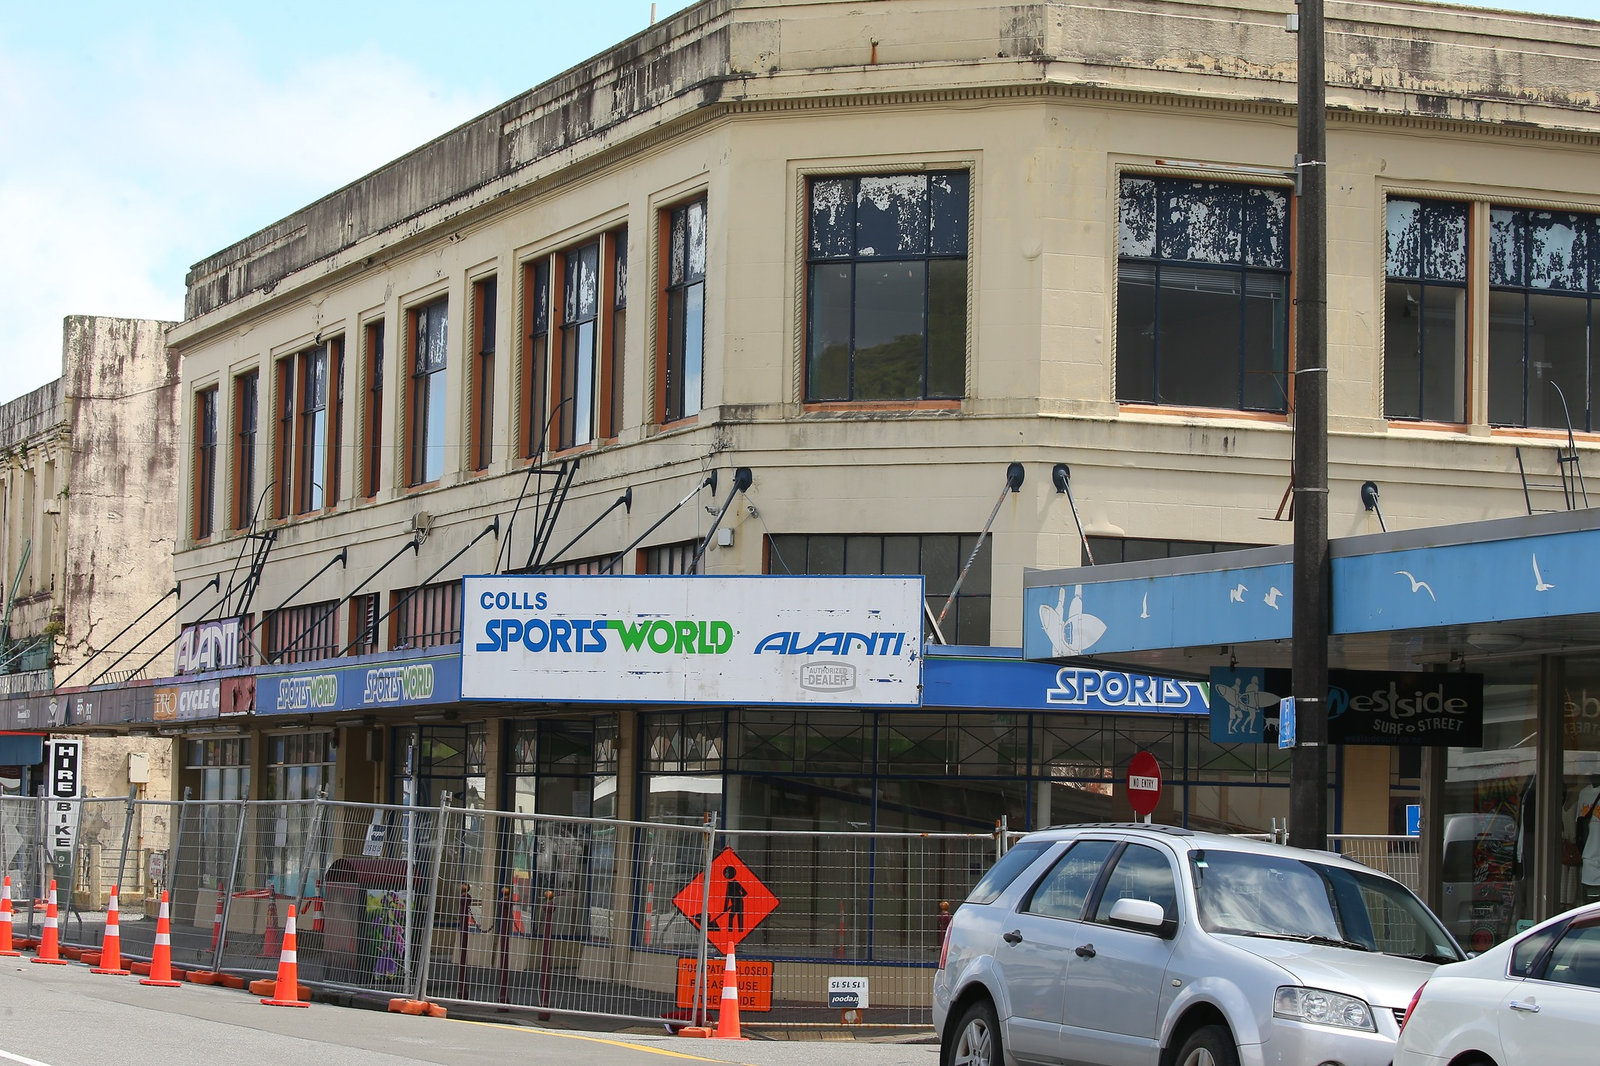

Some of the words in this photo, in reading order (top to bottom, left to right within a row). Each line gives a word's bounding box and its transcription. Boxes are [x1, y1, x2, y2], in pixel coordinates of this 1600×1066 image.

[480, 591, 548, 610] COLLS
[753, 631, 906, 656] AVANTI
[808, 675, 847, 686] DEALER
[154, 691, 177, 714] PRO
[180, 689, 210, 711] CYCLE
[1373, 719, 1404, 735] SURF
[1417, 718, 1464, 733] STREET
[57, 746, 75, 792] HIRE
[1133, 778, 1139, 788] NO
[1141, 778, 1154, 789] ENTRY
[55, 802, 72, 847] BIKE
[682, 963, 726, 974] FOOPATH
[690, 979, 724, 990] PAS
[740, 981, 759, 991] USE
[740, 996, 756, 1006] IDE
